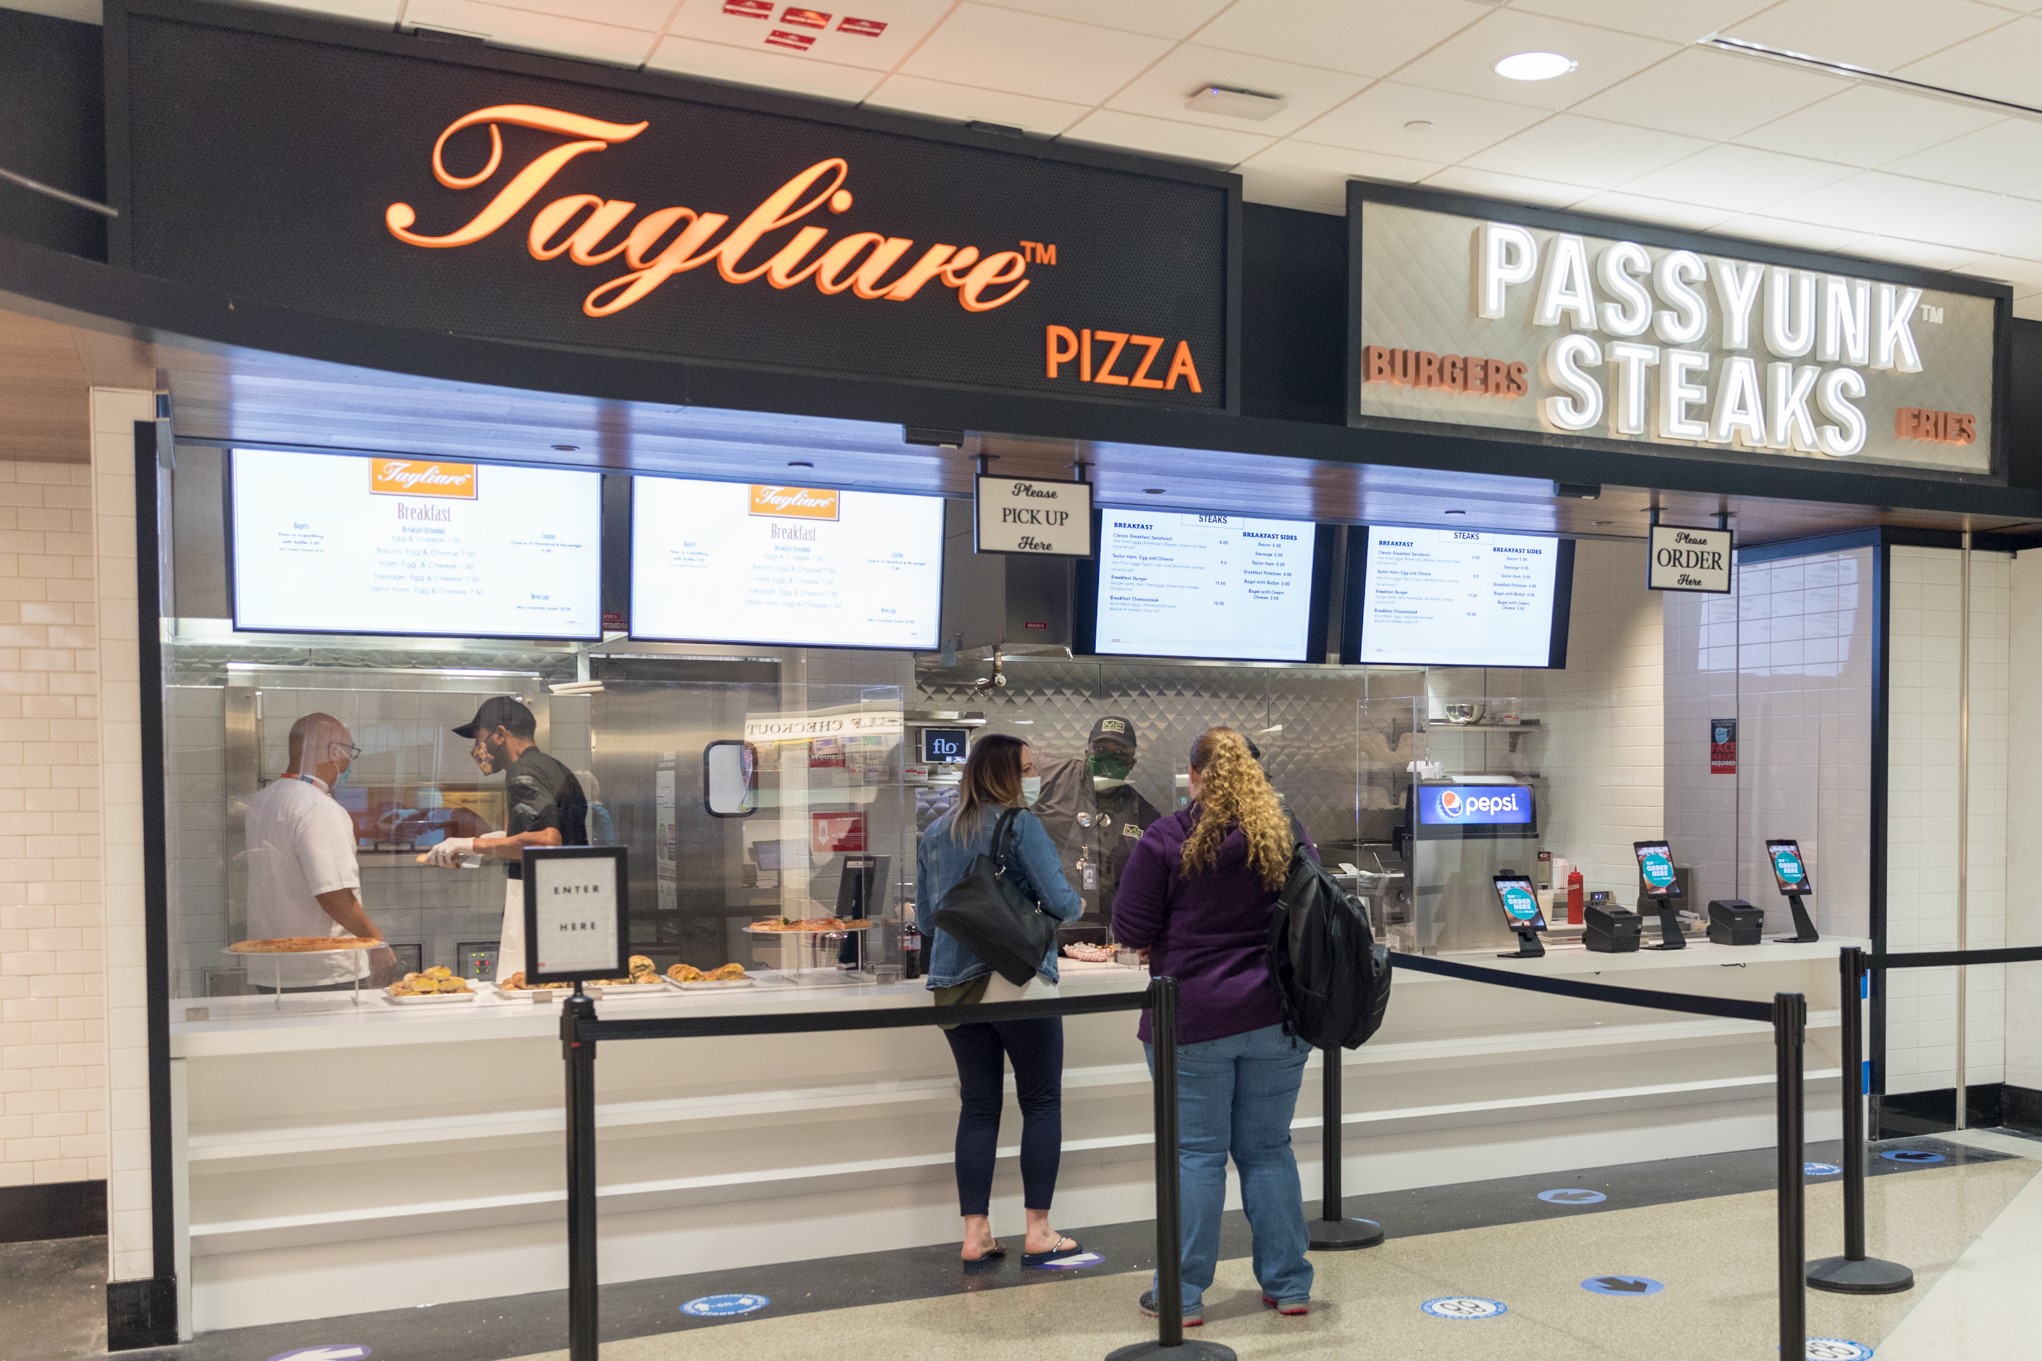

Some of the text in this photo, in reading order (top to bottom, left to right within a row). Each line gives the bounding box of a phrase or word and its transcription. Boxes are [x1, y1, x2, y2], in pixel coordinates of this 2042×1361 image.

[386, 103, 1031, 317] Tagliare
[1477, 222, 1923, 374] PASSYUNK
[1046, 325, 1203, 394] PIZZA
[1364, 344, 1528, 397] BURGERS
[1546, 335, 1867, 457] STEAKS
[1895, 407, 1977, 446] FRIES
[378, 462, 467, 489] Tagliare
[755, 486, 832, 511] Tagliare
[1012, 483, 1058, 499] Please
[397, 502, 451, 522] Breakfast
[1002, 508, 1069, 526] PICK UP
[1198, 514, 1228, 525] STEAKS
[771, 523, 817, 541] Breakfast
[1114, 522, 1154, 530] BREAKFAST
[1018, 536, 1053, 551] Here
[1243, 531, 1279, 540] BREAKFAST
[1453, 531, 1480, 541] STEAKS
[1675, 532, 1708, 545] Please
[1378, 540, 1413, 548] BREAKFAST
[1493, 546, 1525, 554] BREAKFAST
[1657, 548, 1723, 571] ORDER
[1677, 574, 1702, 586] Here
[932, 738, 957, 754] flo
[1711, 742, 1736, 753] FACE
[1465, 793, 1517, 816] pepsi
[1646, 864, 1668, 872] ORDER
[554, 885, 600, 895] ENTER
[560, 921, 596, 931] HERE
